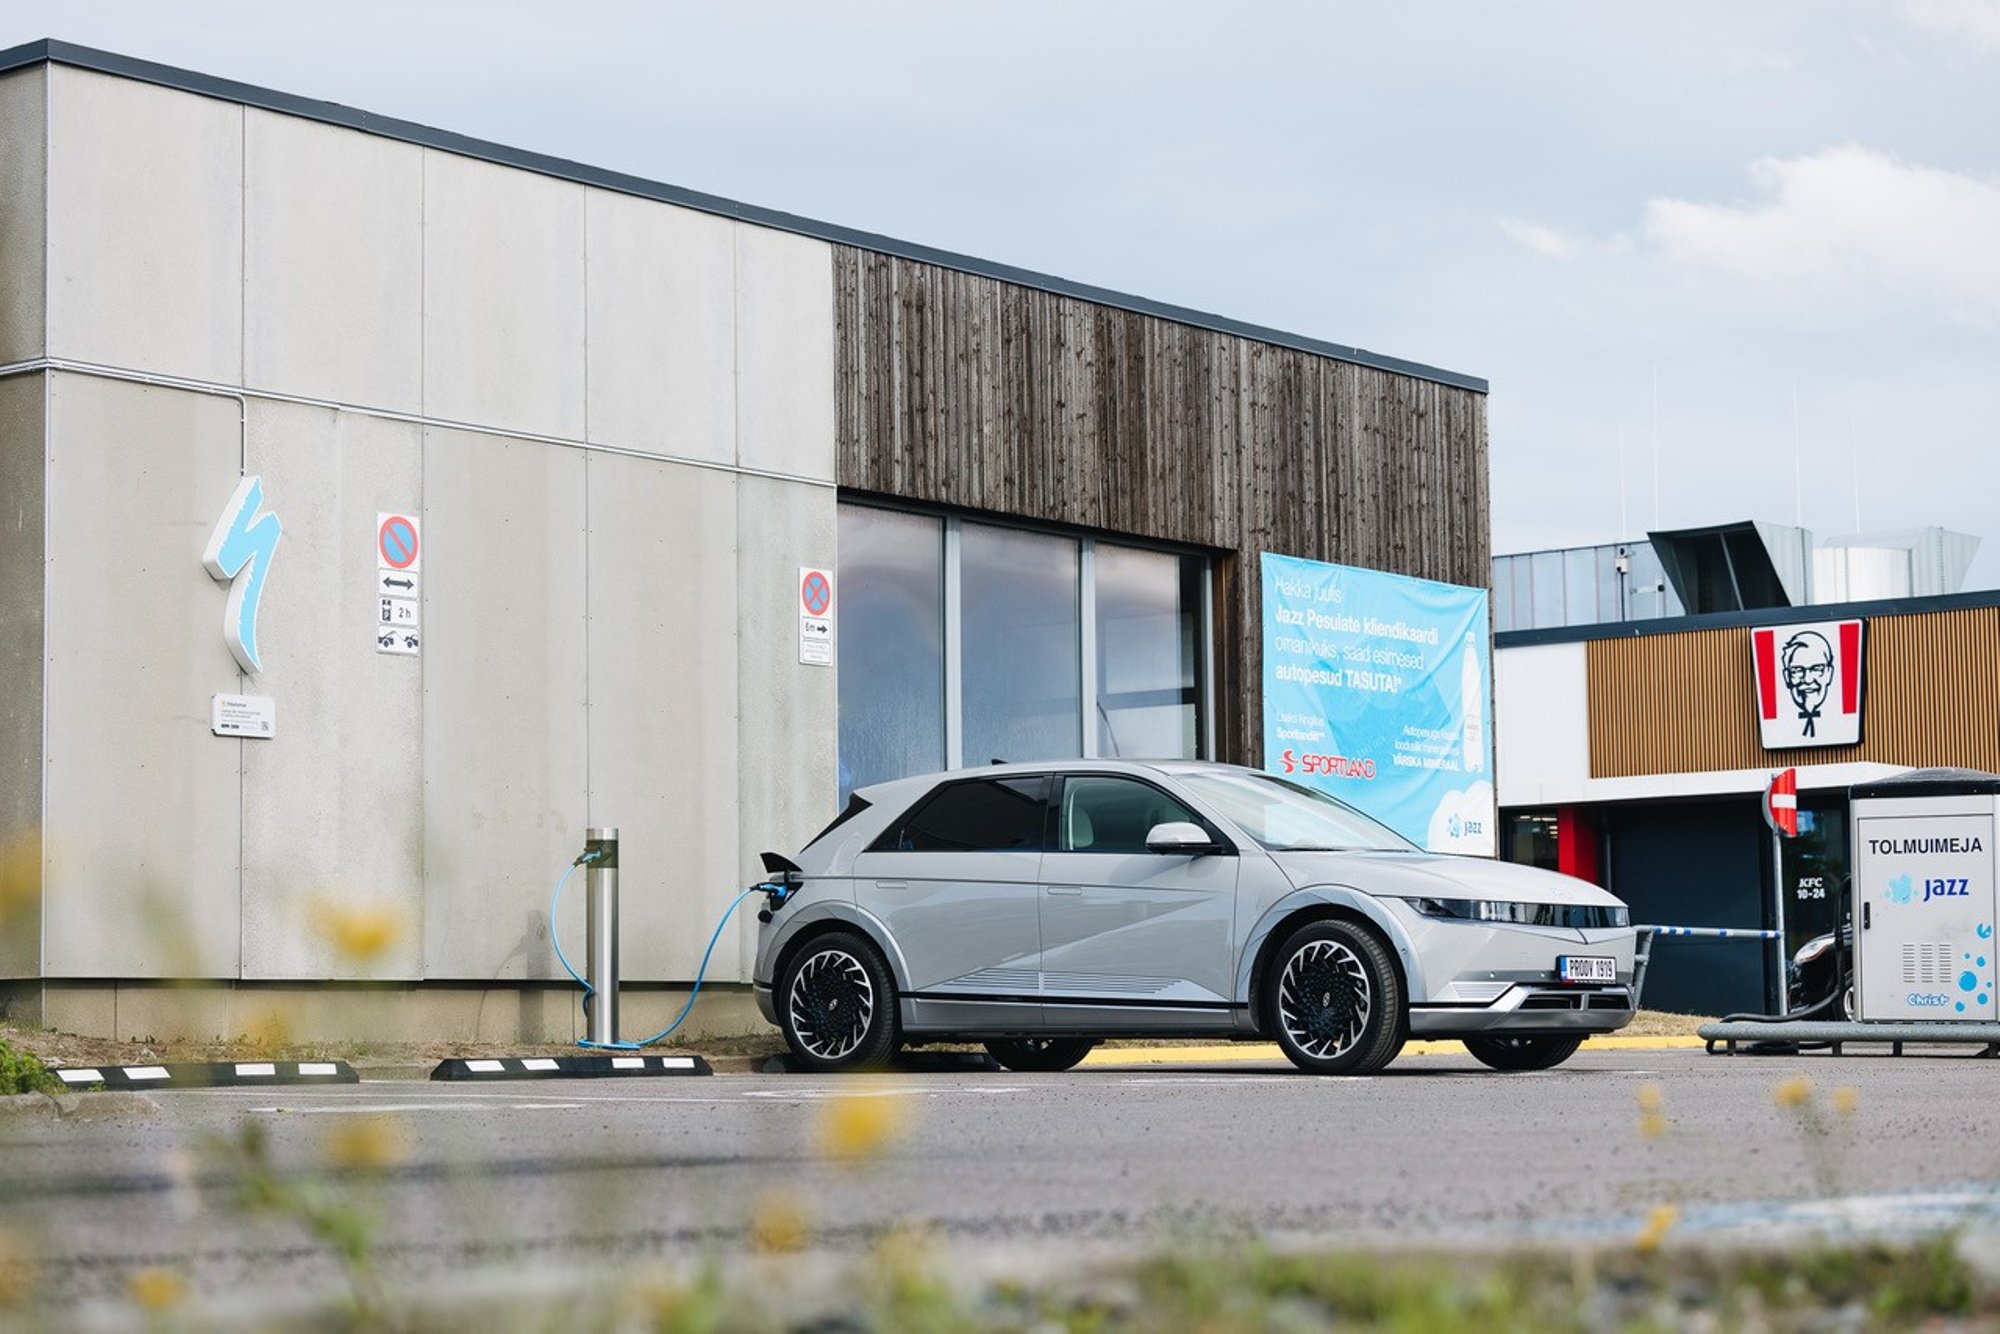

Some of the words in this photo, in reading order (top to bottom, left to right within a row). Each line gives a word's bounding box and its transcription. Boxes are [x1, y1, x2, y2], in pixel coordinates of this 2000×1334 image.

[1274, 576, 1312, 599] Hakka
[398, 607, 404, 618] 2
[405, 608, 411, 619] h
[1275, 604, 1305, 626] Jazz
[1307, 609, 1361, 634] Pesulate
[1363, 616, 1439, 646] kliendikaardi
[1344, 648, 1371, 663] saad
[1372, 650, 1425, 671] esimesed
[1275, 665, 1343, 687] autopesud
[1302, 754, 1376, 779] SPORTLAND
[1464, 821, 1482, 836] jazz
[1868, 837, 1983, 854] TOLMUIMEJA
[1798, 877, 1824, 888] KFC
[1923, 878, 1969, 902] jazz
[1796, 888, 1826, 899] 10-24
[1596, 960, 1613, 978] 1919
[1907, 992, 1950, 1006] Christ
